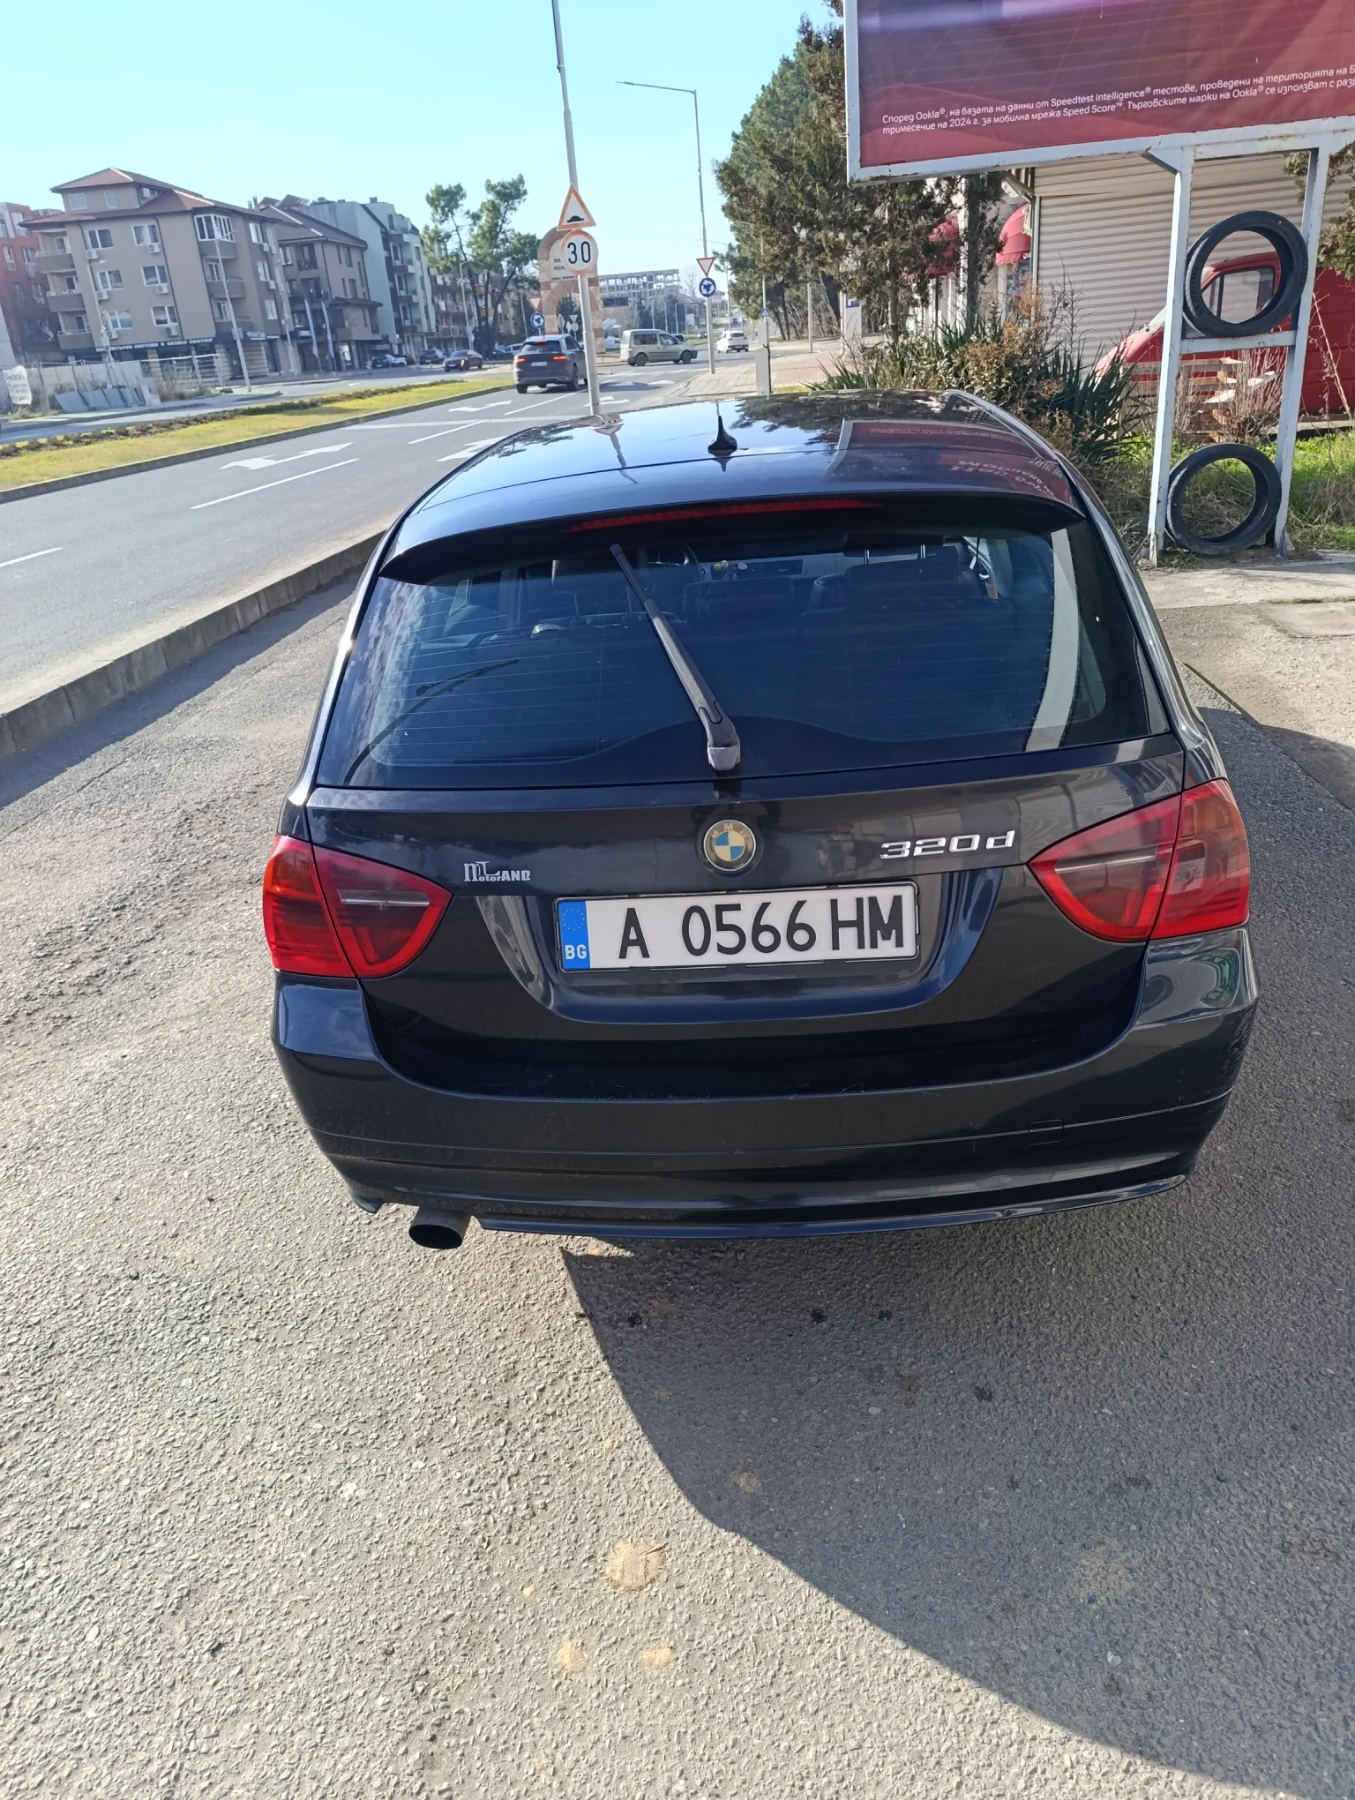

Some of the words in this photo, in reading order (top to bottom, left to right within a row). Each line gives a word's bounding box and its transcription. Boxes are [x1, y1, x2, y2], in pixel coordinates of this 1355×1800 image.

[882, 113, 914, 124] Според
[950, 108, 961, 117] на
[962, 105, 994, 117] базата
[995, 104, 1006, 113] на
[1008, 101, 1034, 112] данни
[1036, 100, 1049, 109] от
[1051, 94, 1094, 108] Speedtest
[1153, 83, 1198, 96] тестове,
[1200, 78, 1251, 91] проведени
[1253, 76, 1264, 84] на
[1266, 69, 1334, 83] територията
[1336, 67, 1347, 76] на
[882, 121, 936, 135] тримесечие
[937, 121, 948, 130] на
[950, 117, 972, 128] 2024
[981, 117, 992, 126] за
[993, 113, 1030, 124] мобилна
[1031, 109, 1061, 121] мрежа
[1062, 104, 1090, 118] Speed
[1127, 96, 1187, 111] Търговските
[1189, 92, 1218, 104] марки
[1219, 91, 1231, 100] на
[1265, 87, 1276, 95] се
[1277, 80, 1328, 95] използват
[1329, 80, 1335, 88] с
[567, 241, 591, 265] 30
[564, 944, 587, 960] BG
[618, 907, 650, 959] A
[681, 899, 817, 957] 0566
[830, 894, 904, 951] HM
